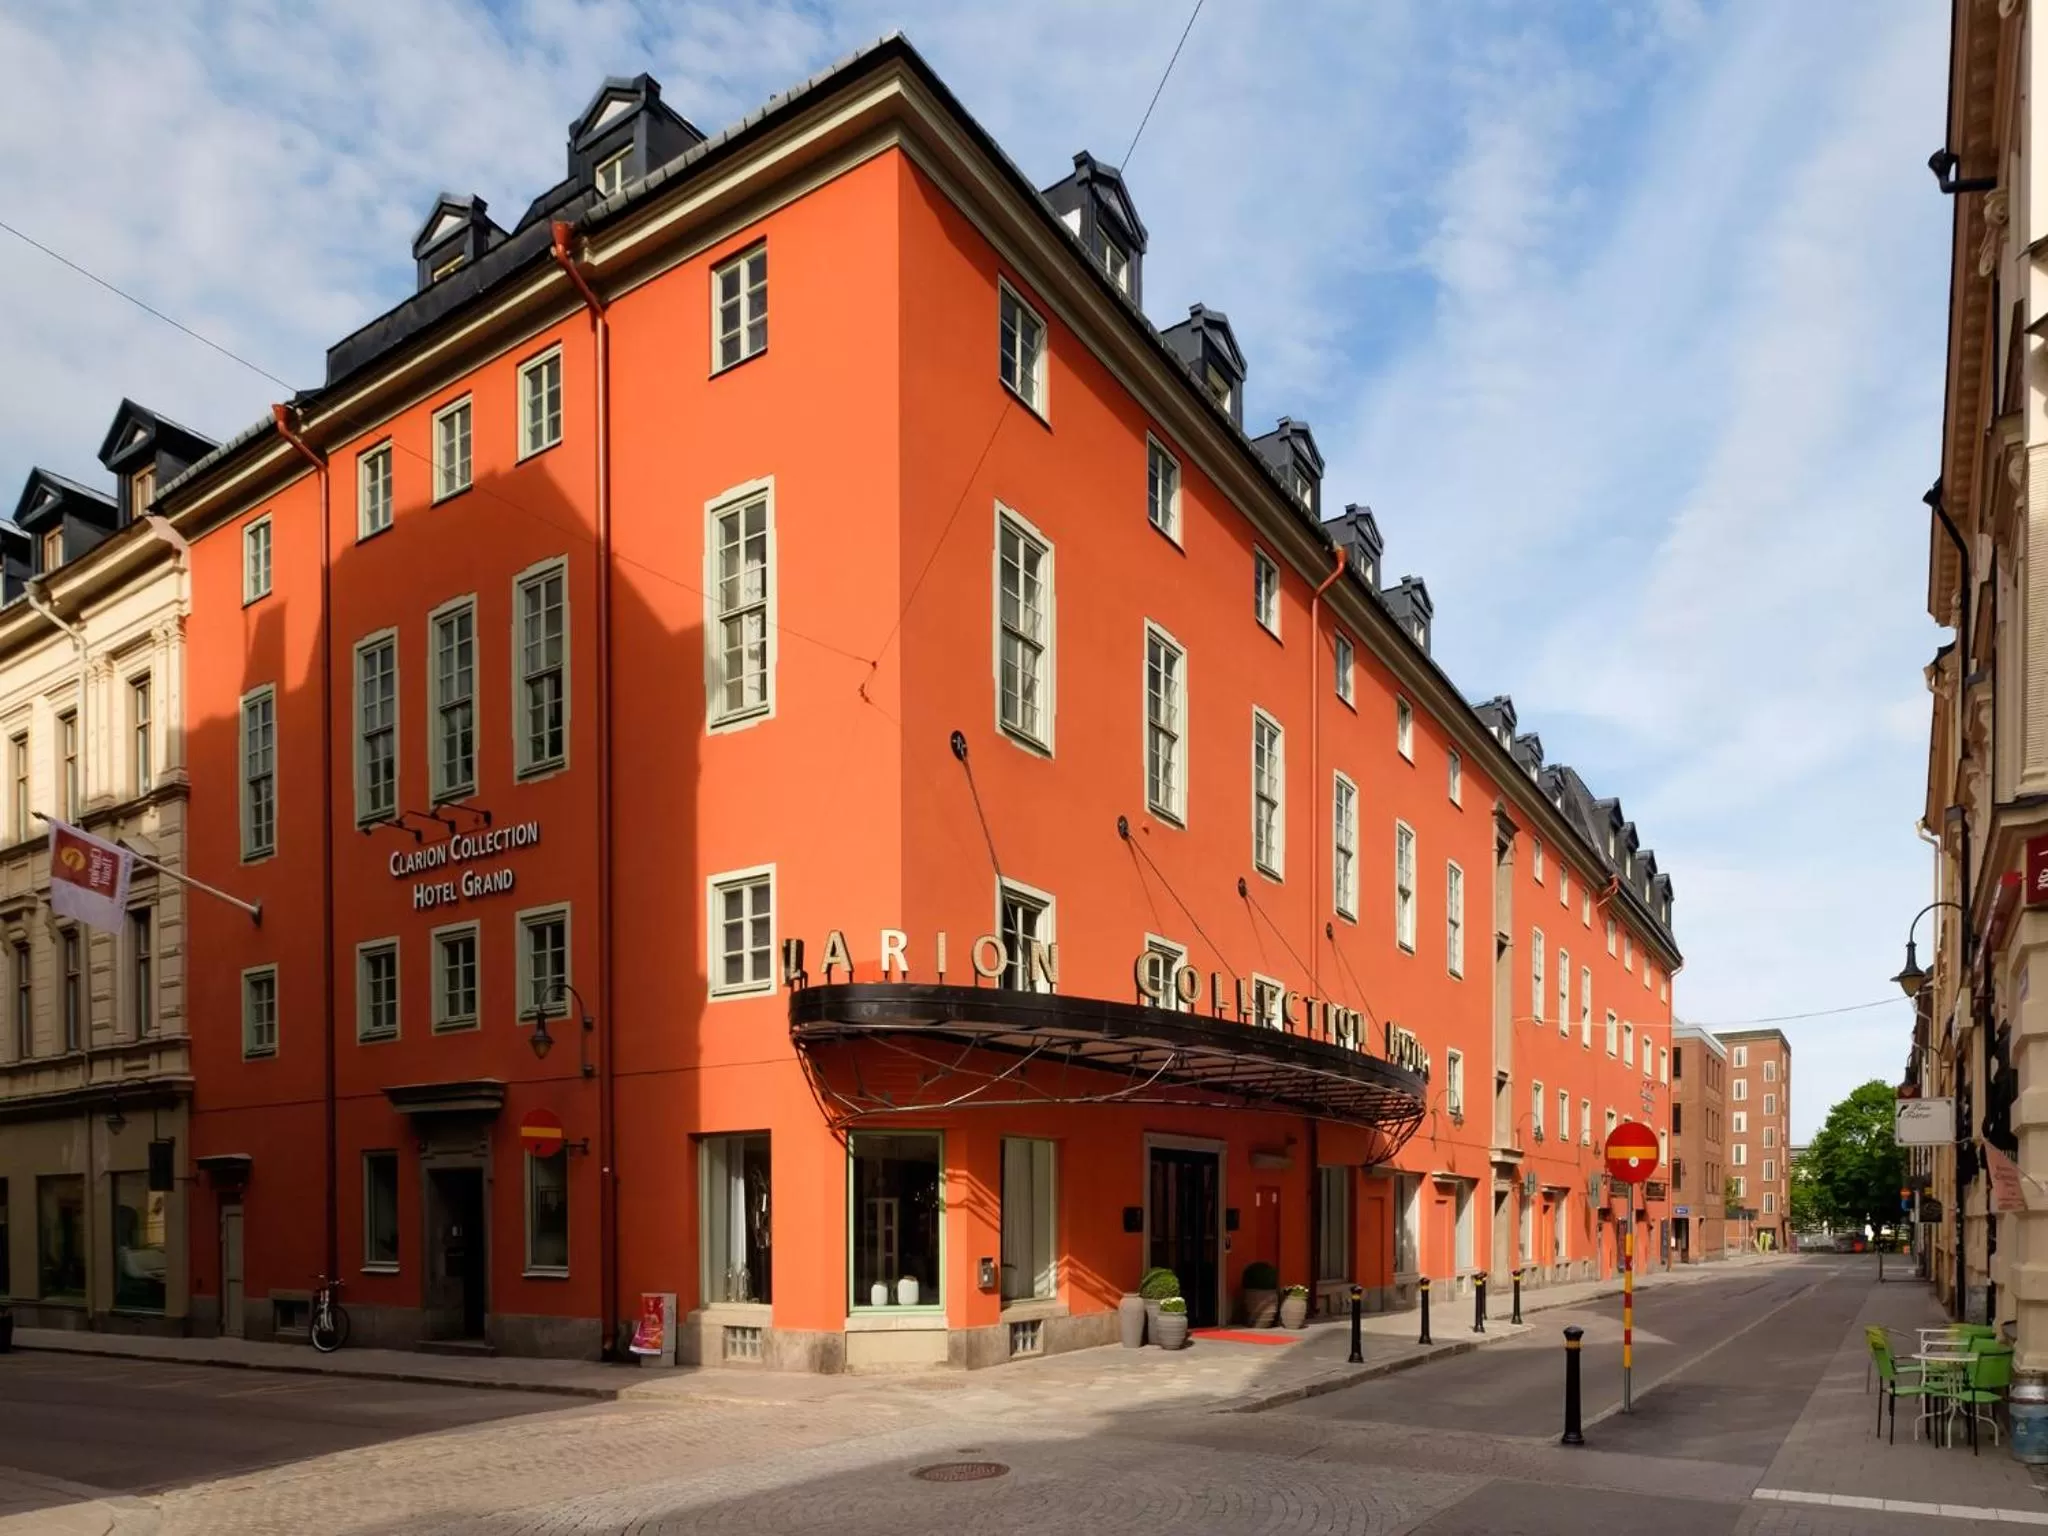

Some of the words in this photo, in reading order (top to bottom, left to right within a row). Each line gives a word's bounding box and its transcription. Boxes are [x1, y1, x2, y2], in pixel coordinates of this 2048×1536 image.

[389, 843, 447, 877] CLARION
[449, 820, 539, 861] COLLECTION
[413, 881, 457, 909] HOTEL
[461, 867, 514, 897] GRAND
[1134, 950, 1369, 1046] COLLECTION
